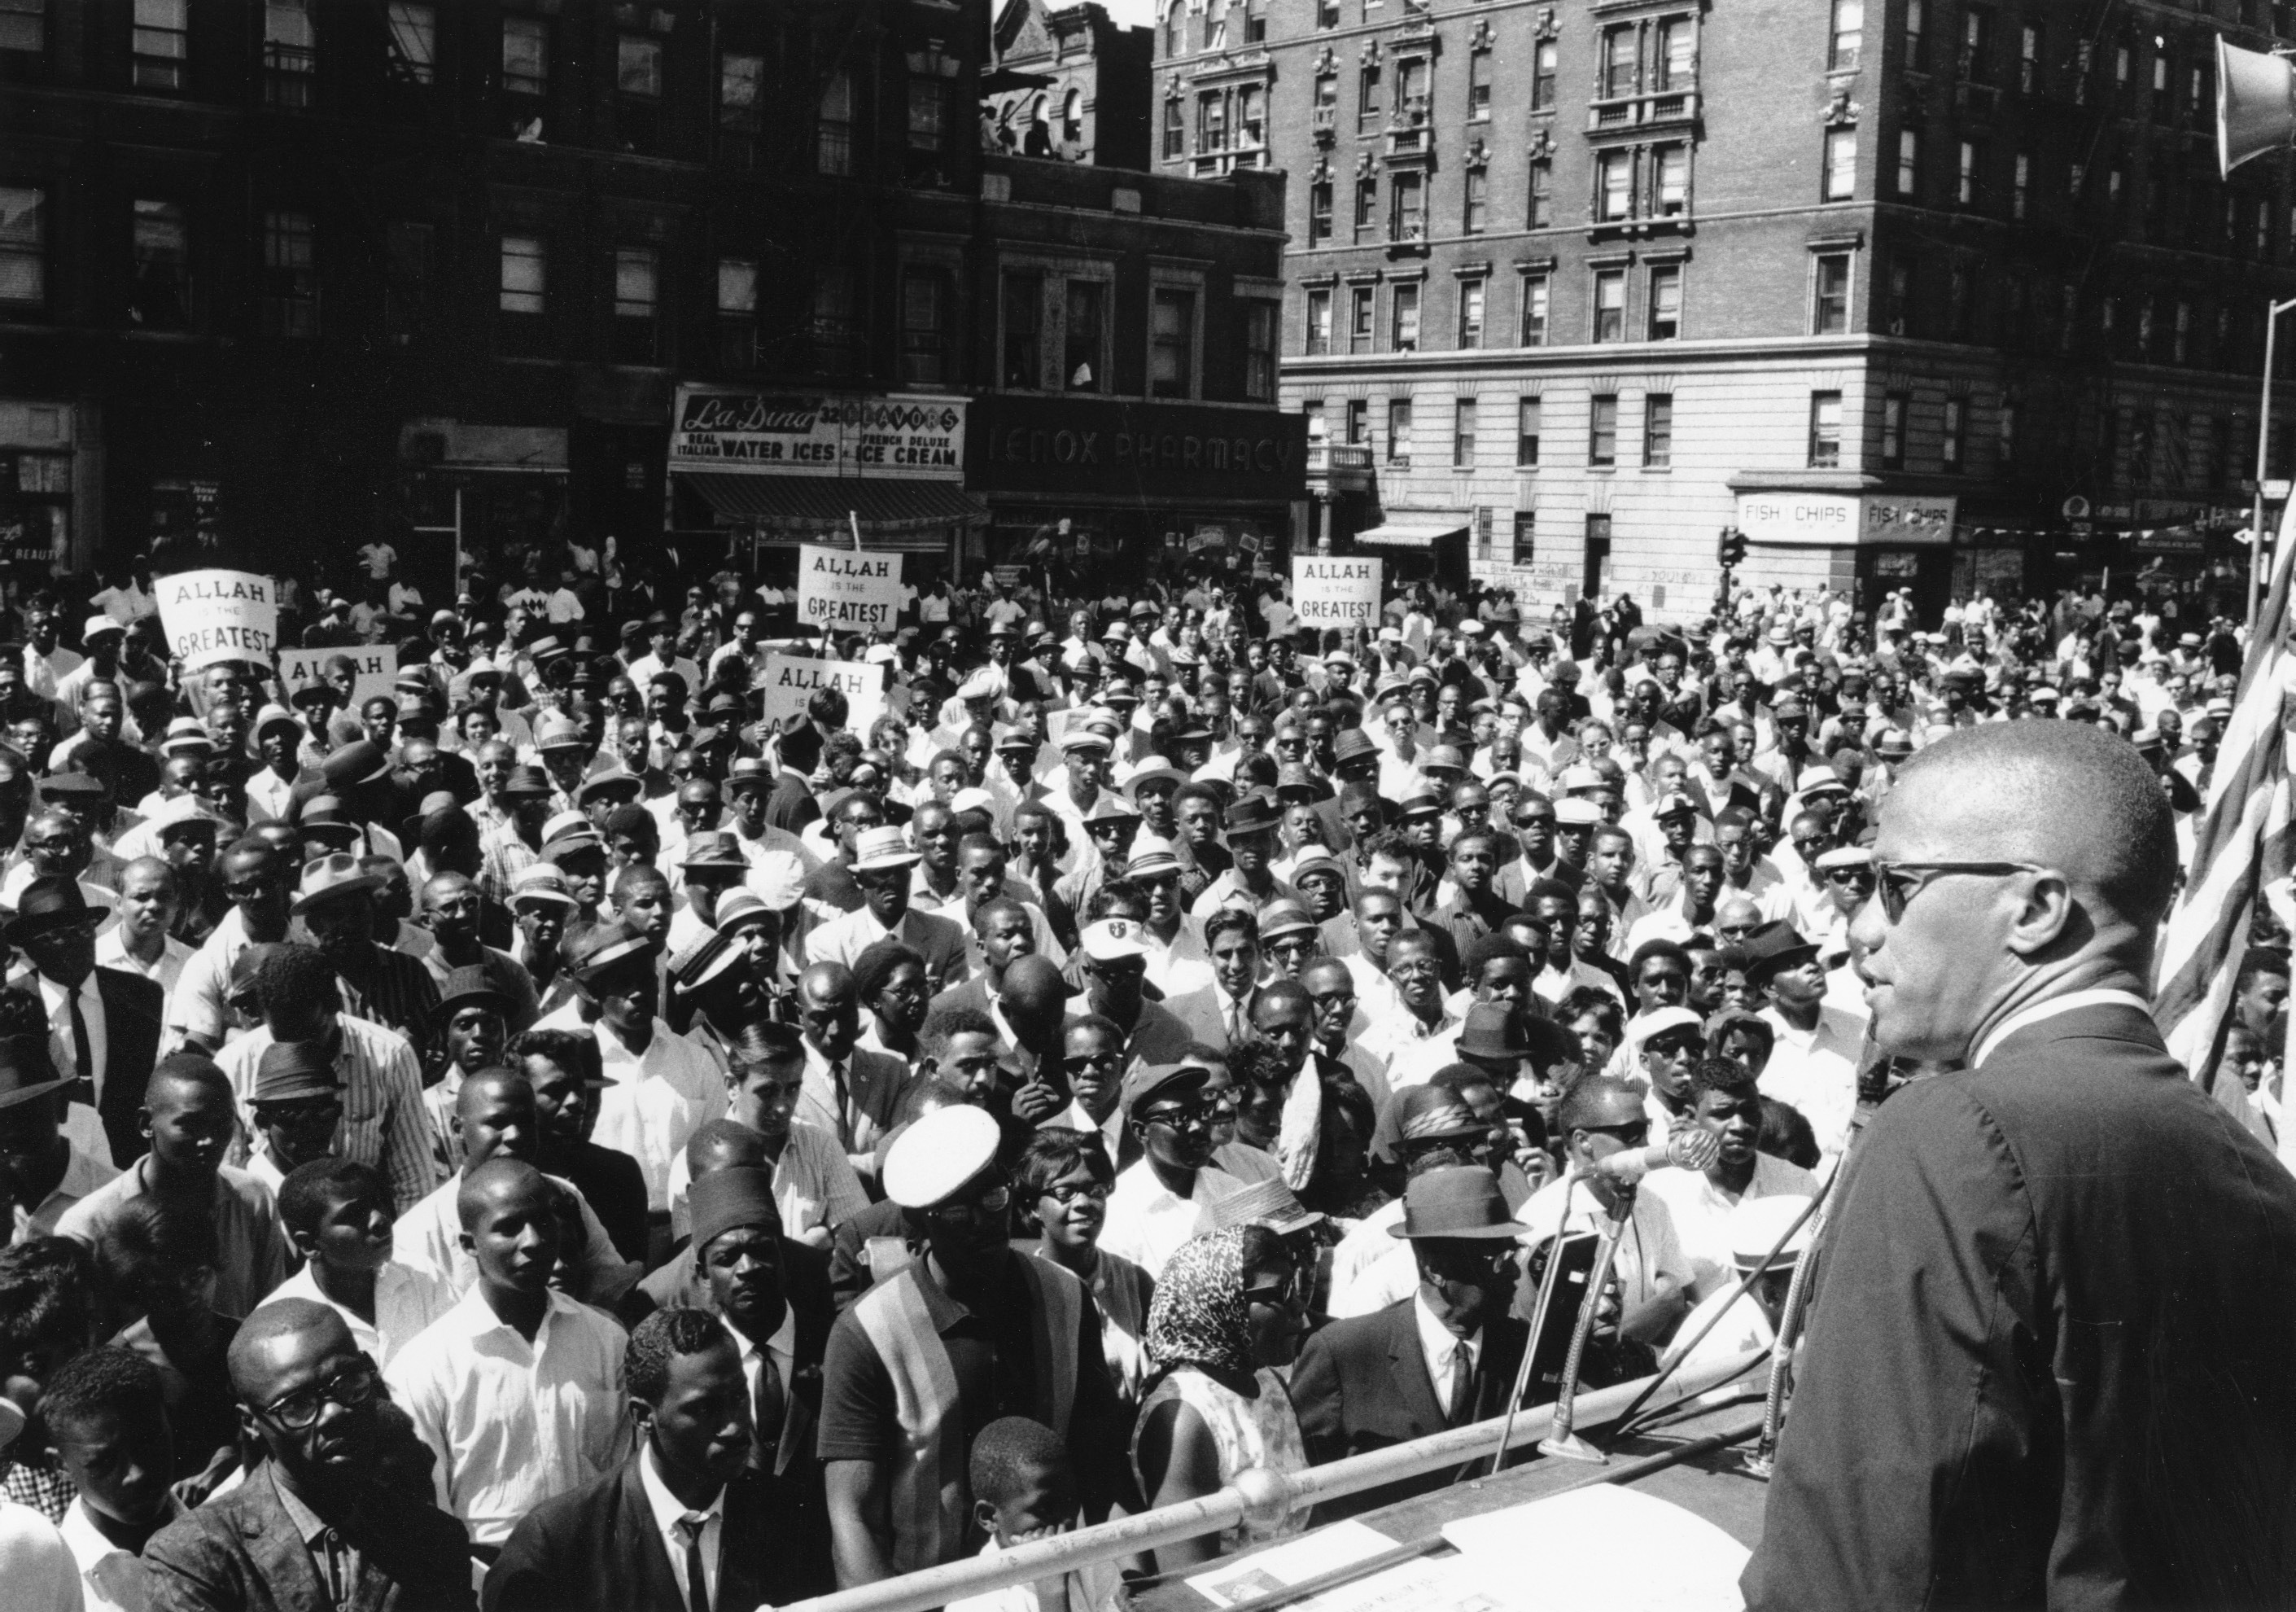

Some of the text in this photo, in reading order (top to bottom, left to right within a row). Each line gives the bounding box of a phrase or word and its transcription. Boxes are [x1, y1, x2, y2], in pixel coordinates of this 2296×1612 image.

[686, 401, 737, 429] La
[820, 406, 957, 431] 32 FLAVORS
[689, 433, 716, 445] REAL
[863, 434, 951, 447] FRENCH DELUXE
[677, 445, 719, 456] ITALIAN
[722, 440, 835, 461] WATER ICES
[855, 445, 956, 465] ICE CREAM
[988, 427, 1296, 472] LENOX PHARMACY
[1745, 506, 1846, 523] FISH CHIPS
[1869, 507, 1900, 523] FISH
[15, 548, 62, 560] BEAUTY
[814, 557, 889, 577] ALLAH
[1304, 564, 1371, 580] ALLAH
[177, 583, 265, 604] ALLAH
[833, 580, 865, 592] IS THE
[216, 607, 241, 616] THE
[808, 597, 888, 622] GREATEST
[1301, 601, 1372, 619] GREATEST
[178, 627, 271, 655] GREATEST
[291, 657, 383, 679] ALAH
[779, 668, 863, 692] ALLAH
